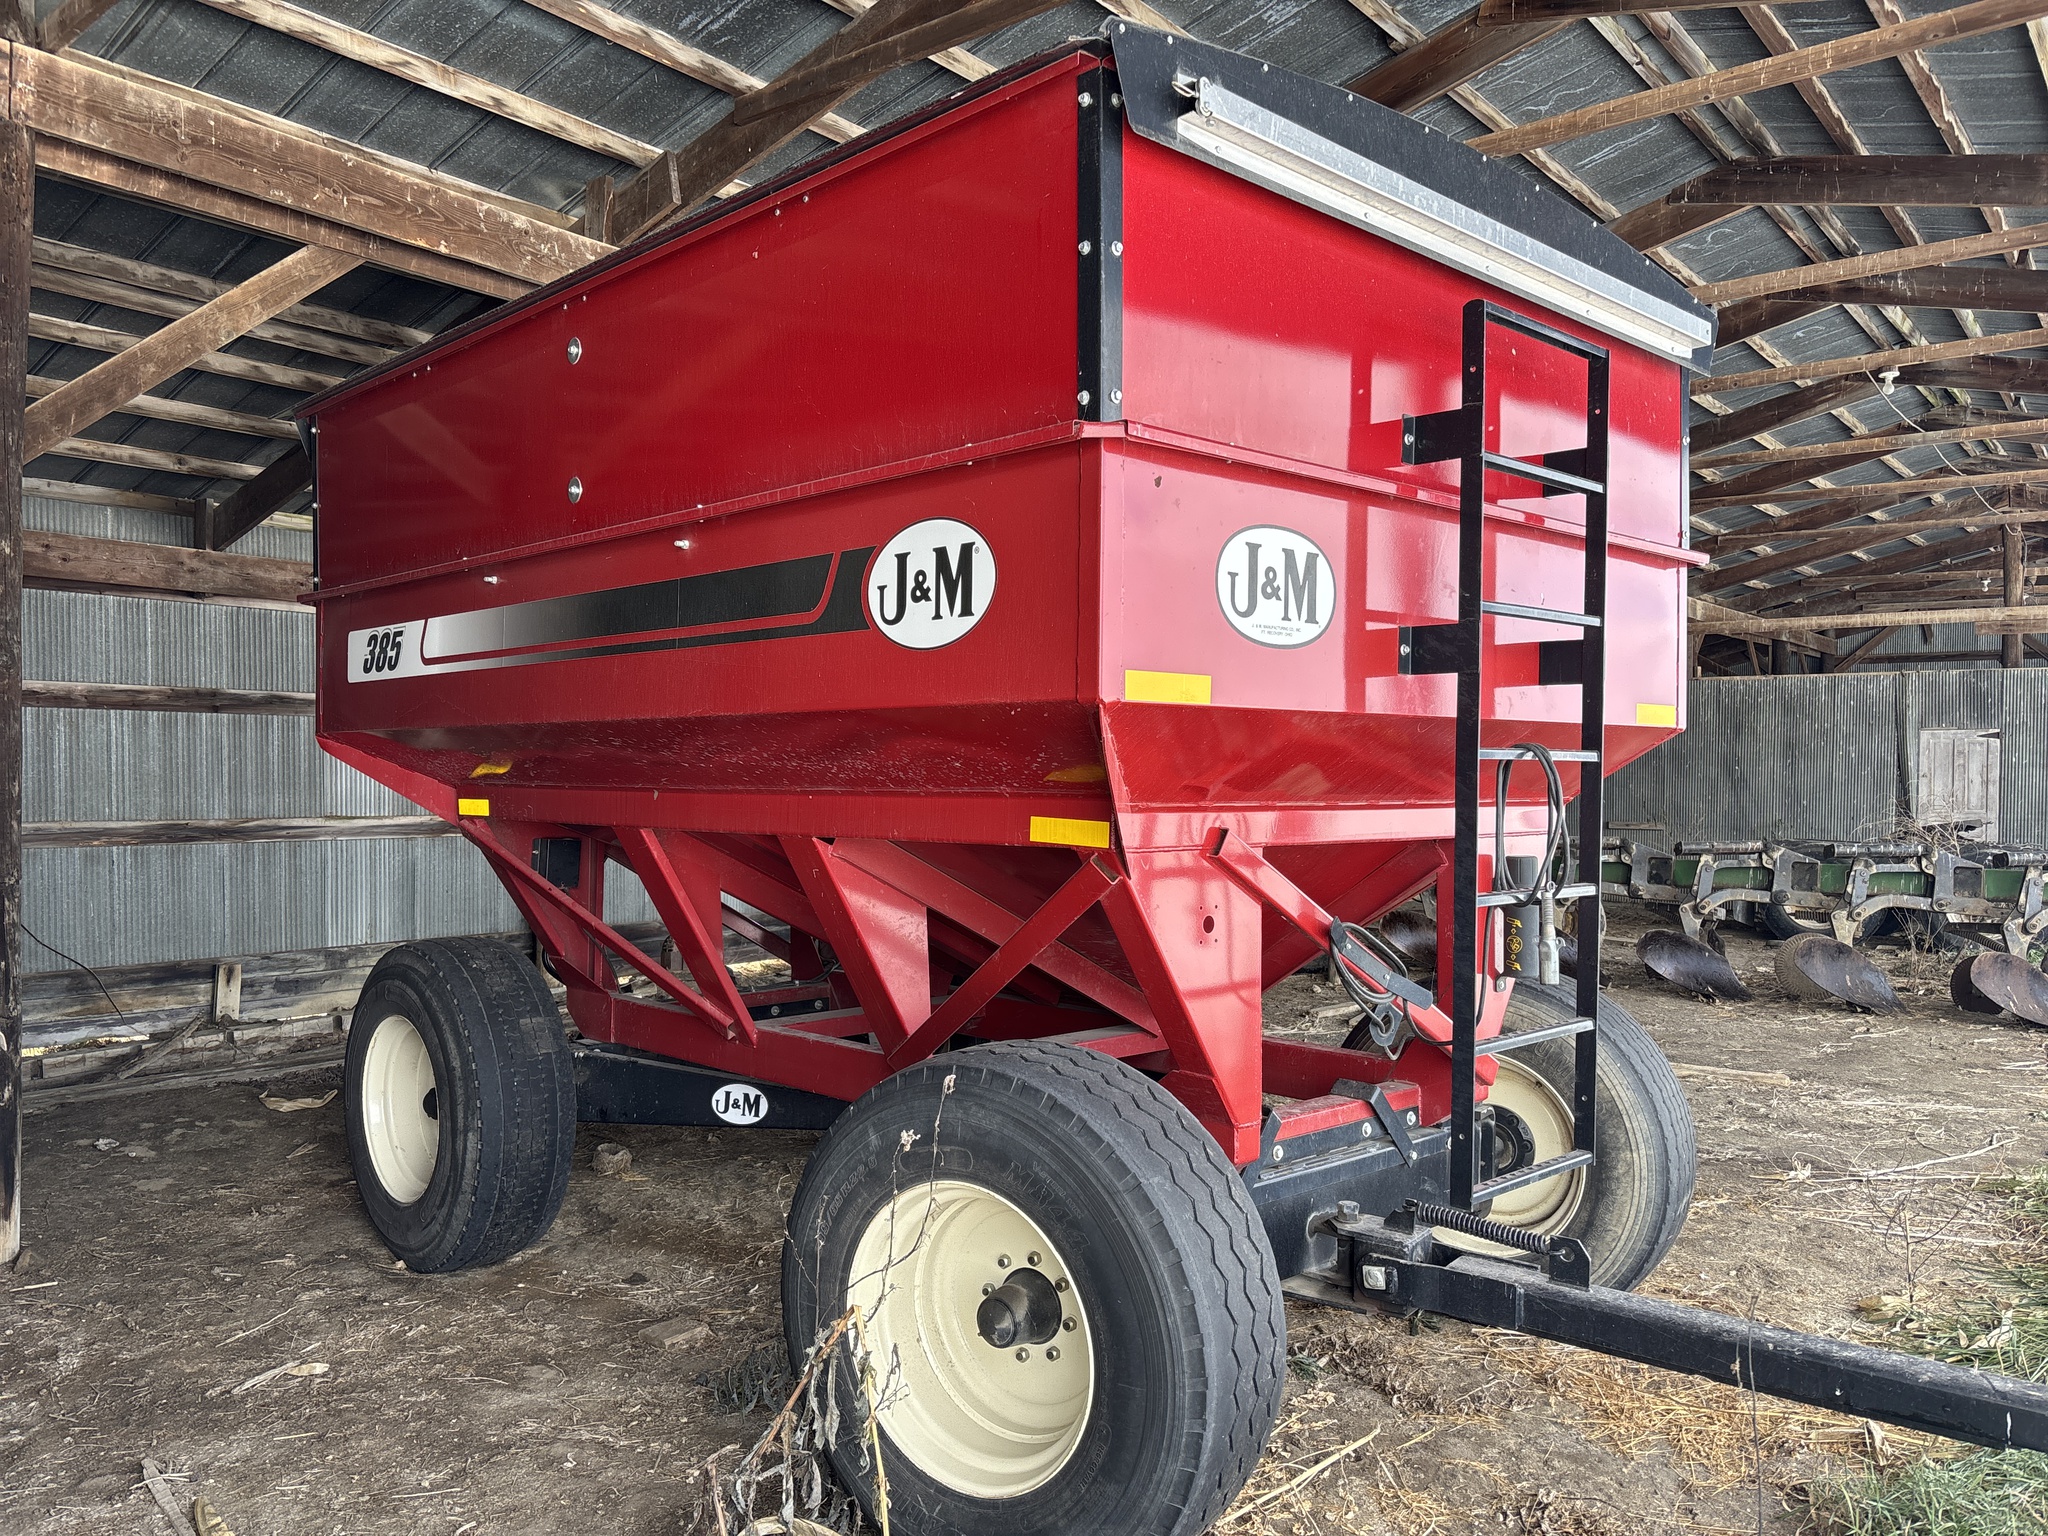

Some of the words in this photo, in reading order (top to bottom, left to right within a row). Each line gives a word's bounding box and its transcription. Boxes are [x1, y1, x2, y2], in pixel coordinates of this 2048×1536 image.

[363, 627, 405, 674] 385
[715, 1090, 762, 1118] J&M
[814, 1156, 877, 1252] 5/65R22.5
